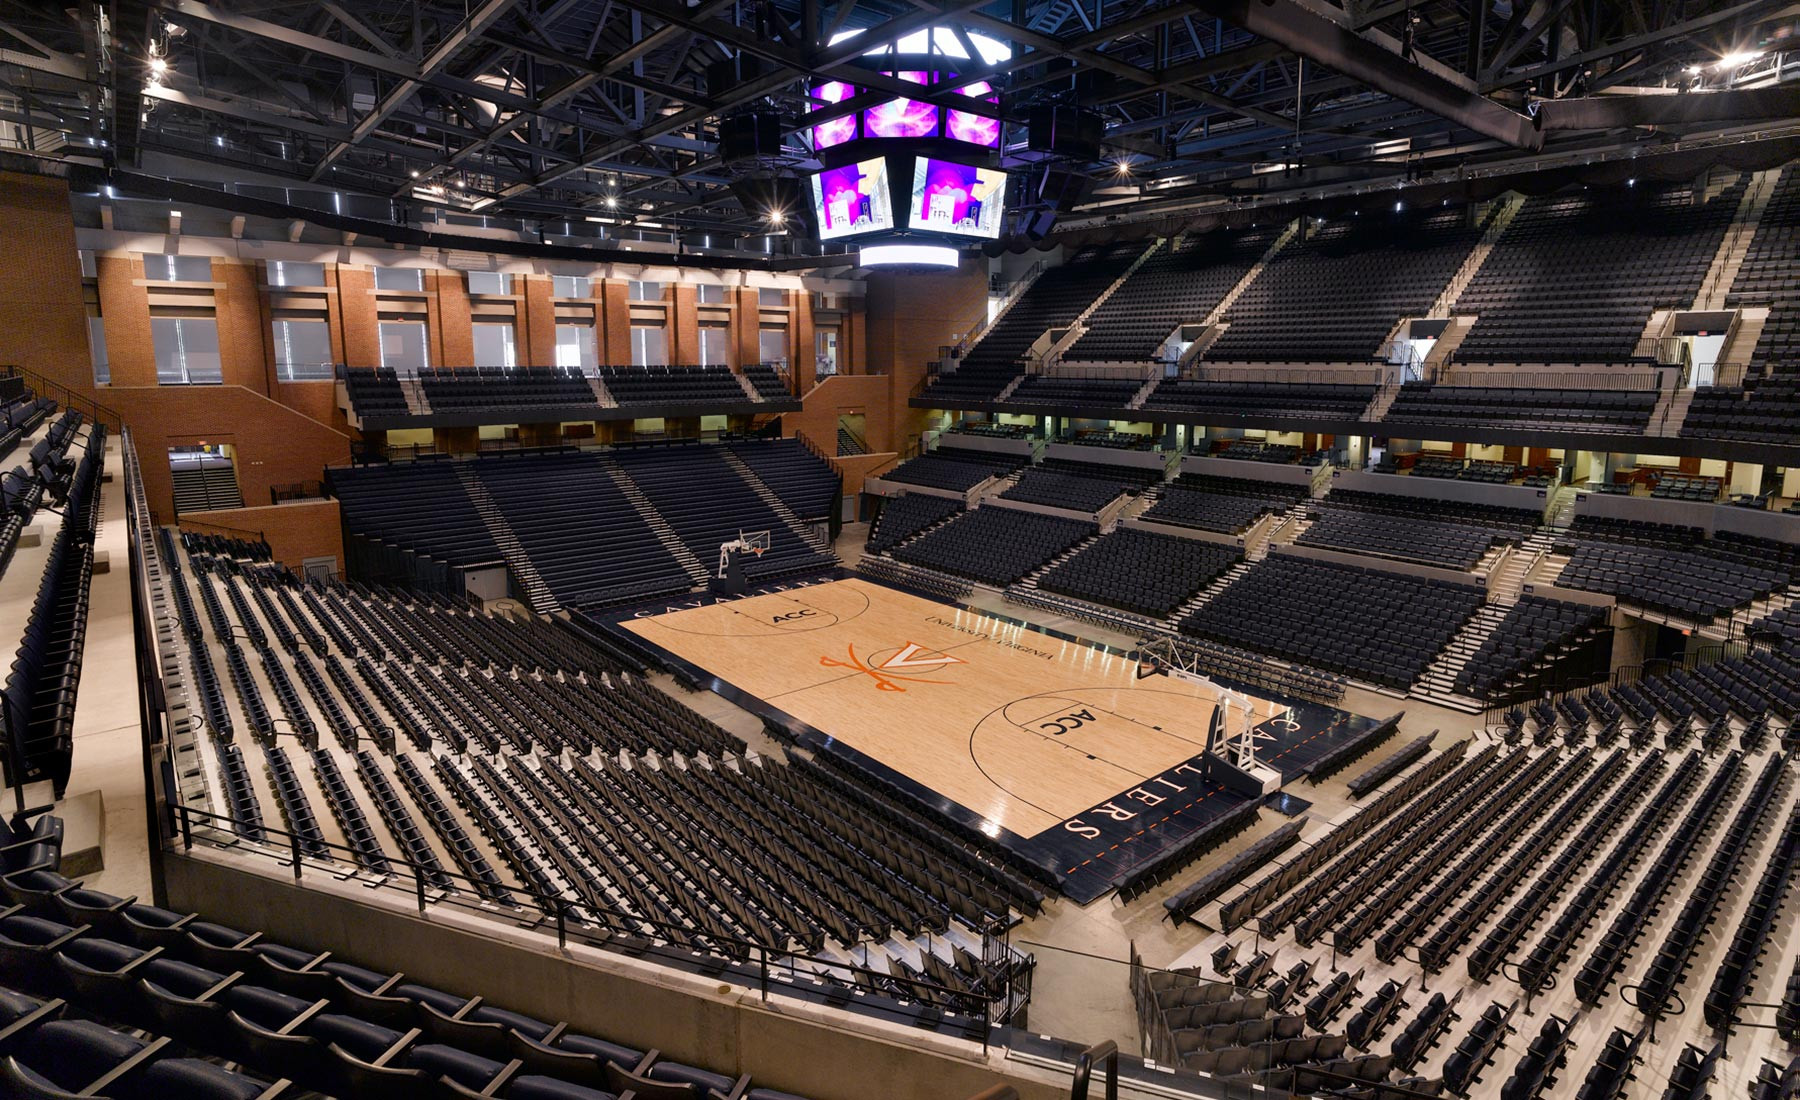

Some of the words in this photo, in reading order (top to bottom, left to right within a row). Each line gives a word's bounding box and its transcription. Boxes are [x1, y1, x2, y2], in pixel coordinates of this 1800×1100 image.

[634, 577, 834, 618] CAVALIERS
[772, 609, 817, 623] ACC
[1040, 709, 1096, 735] ACC
[1064, 718, 1301, 841] CAVLIERS
